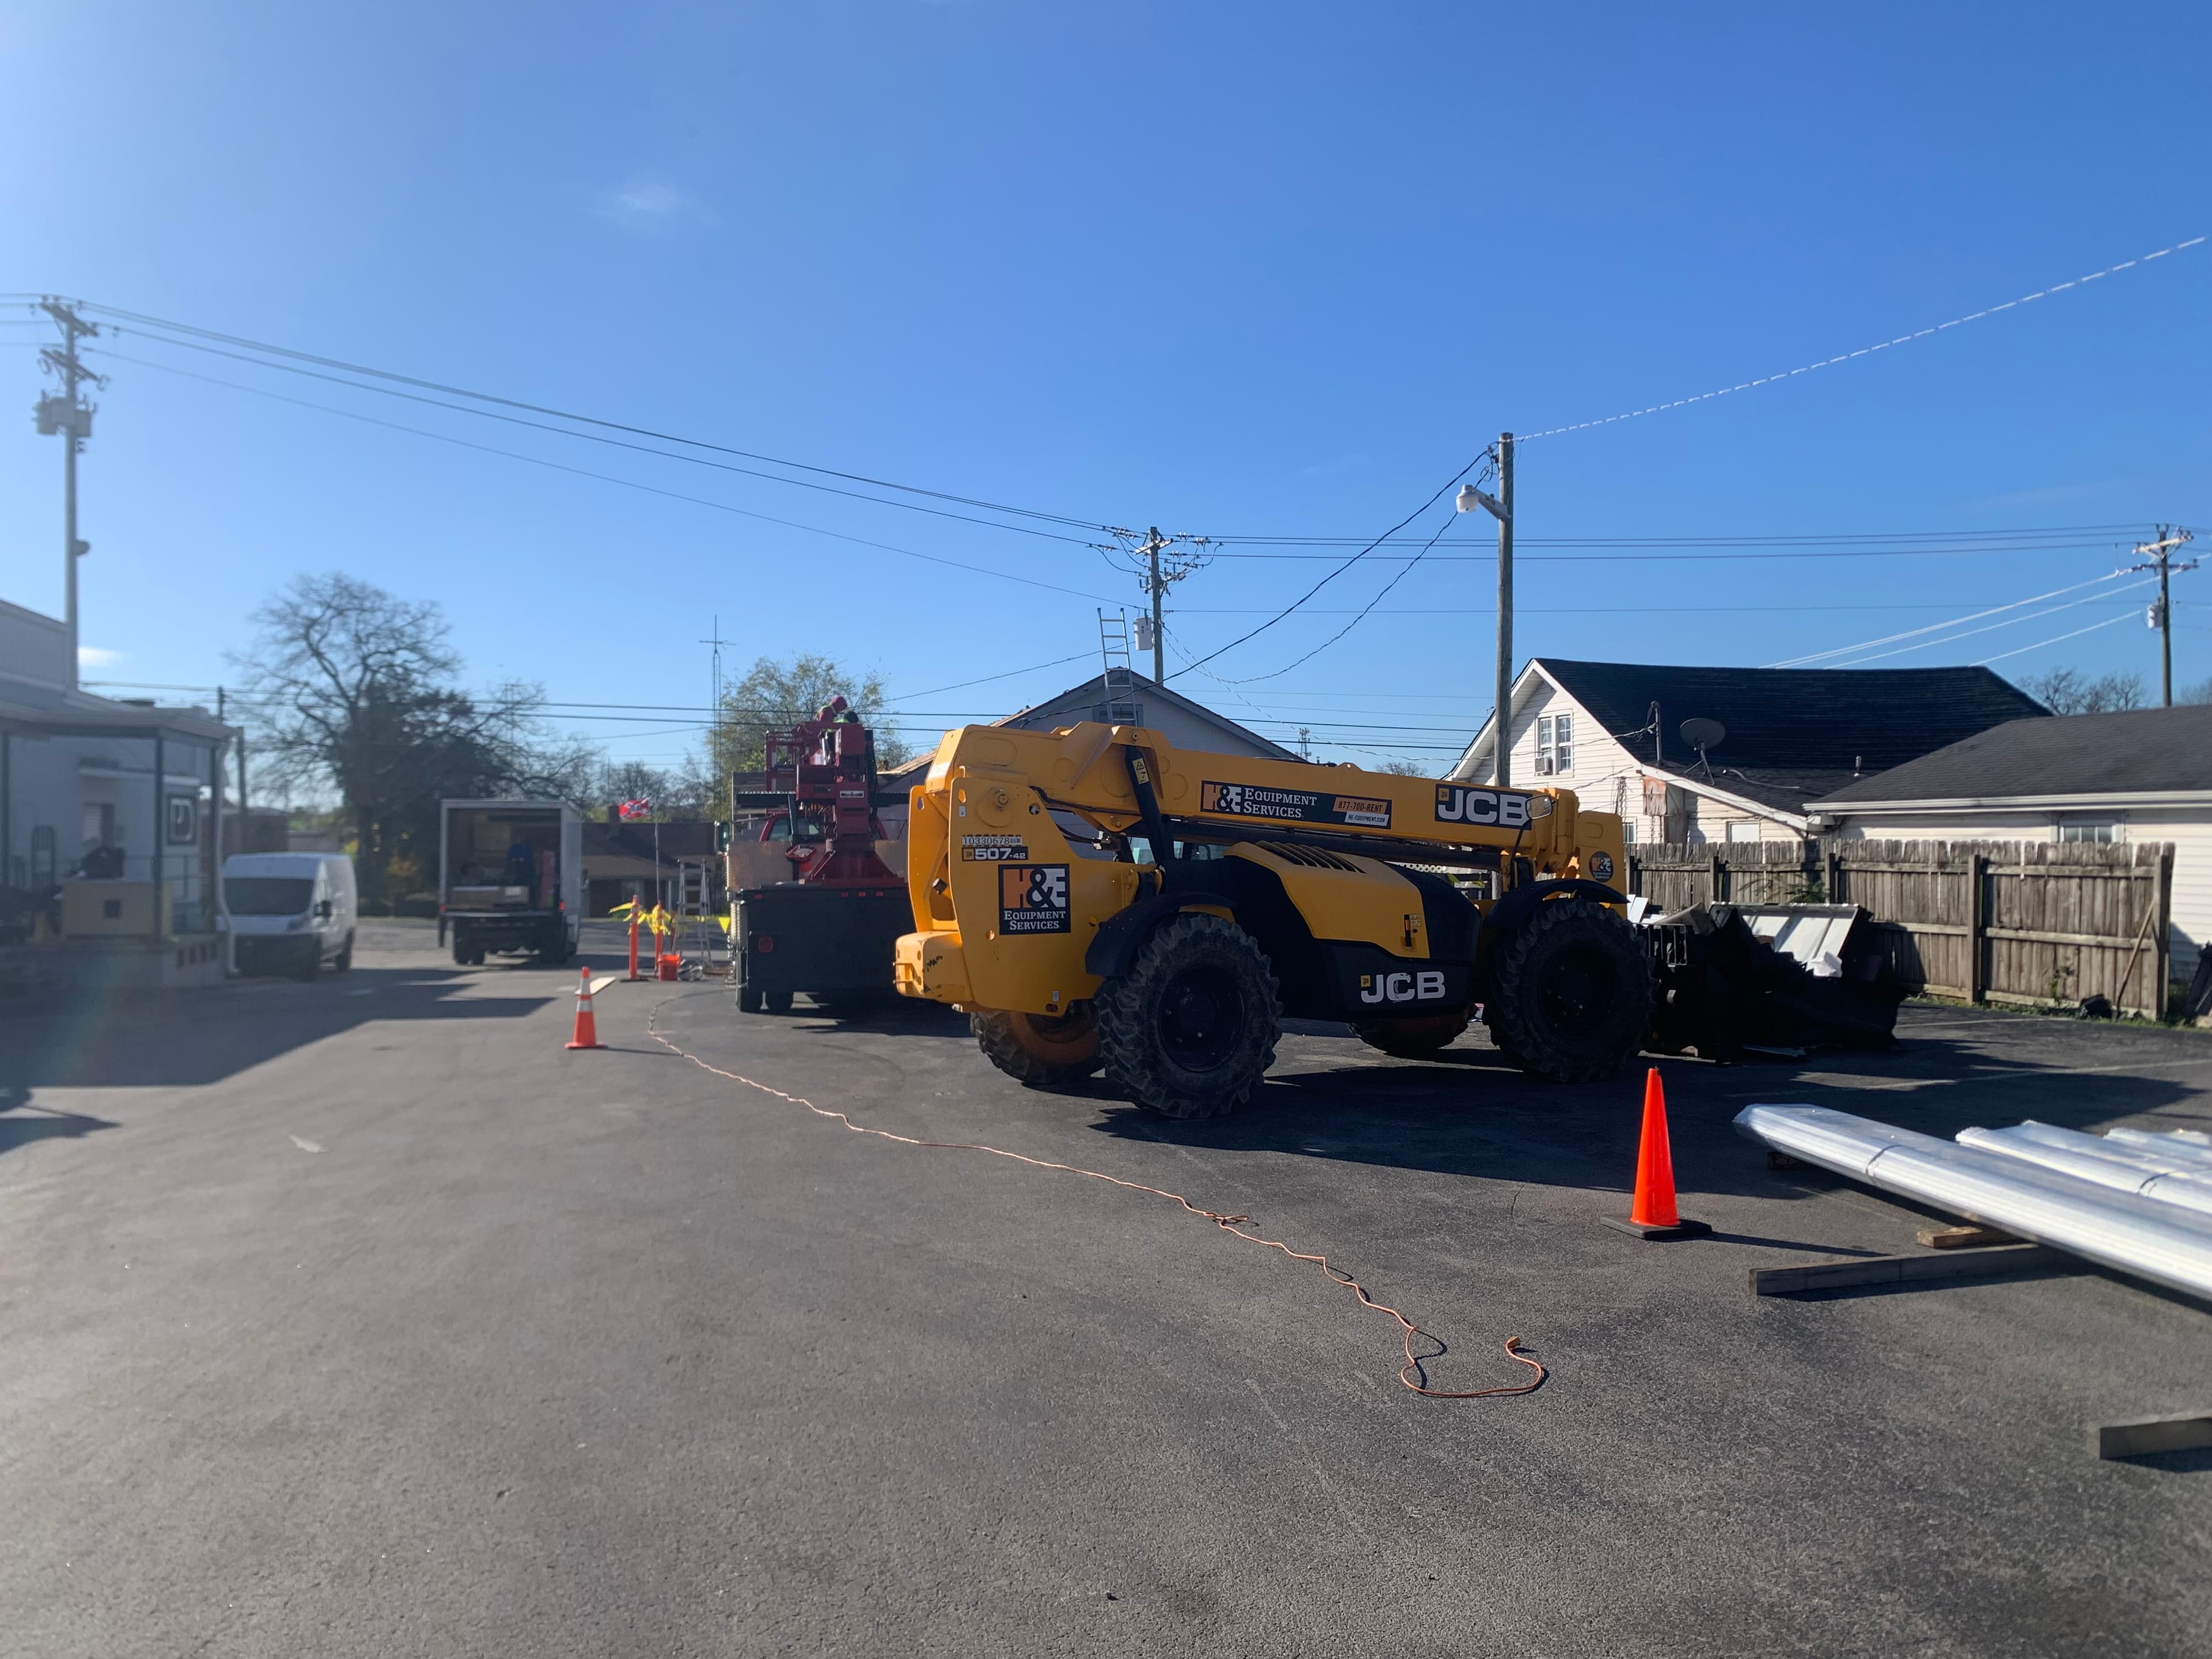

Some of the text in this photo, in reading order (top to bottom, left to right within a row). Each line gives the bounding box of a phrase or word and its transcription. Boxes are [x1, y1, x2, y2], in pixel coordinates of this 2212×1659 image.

[1203, 783, 1241, 813] H&E
[1244, 787, 1317, 806] EQUIPMENT
[1243, 801, 1302, 819] SERVICES
[1338, 801, 1383, 813] 877-700-RENT
[1438, 789, 1530, 826] JCB
[963, 837, 1010, 845] 10330678
[975, 847, 1026, 860] 507-42
[1003, 868, 1066, 908] H&E
[1004, 911, 1066, 920] EQUIPMENT
[1009, 921, 1059, 930] SERVICES
[1361, 971, 1446, 1003] JCB
